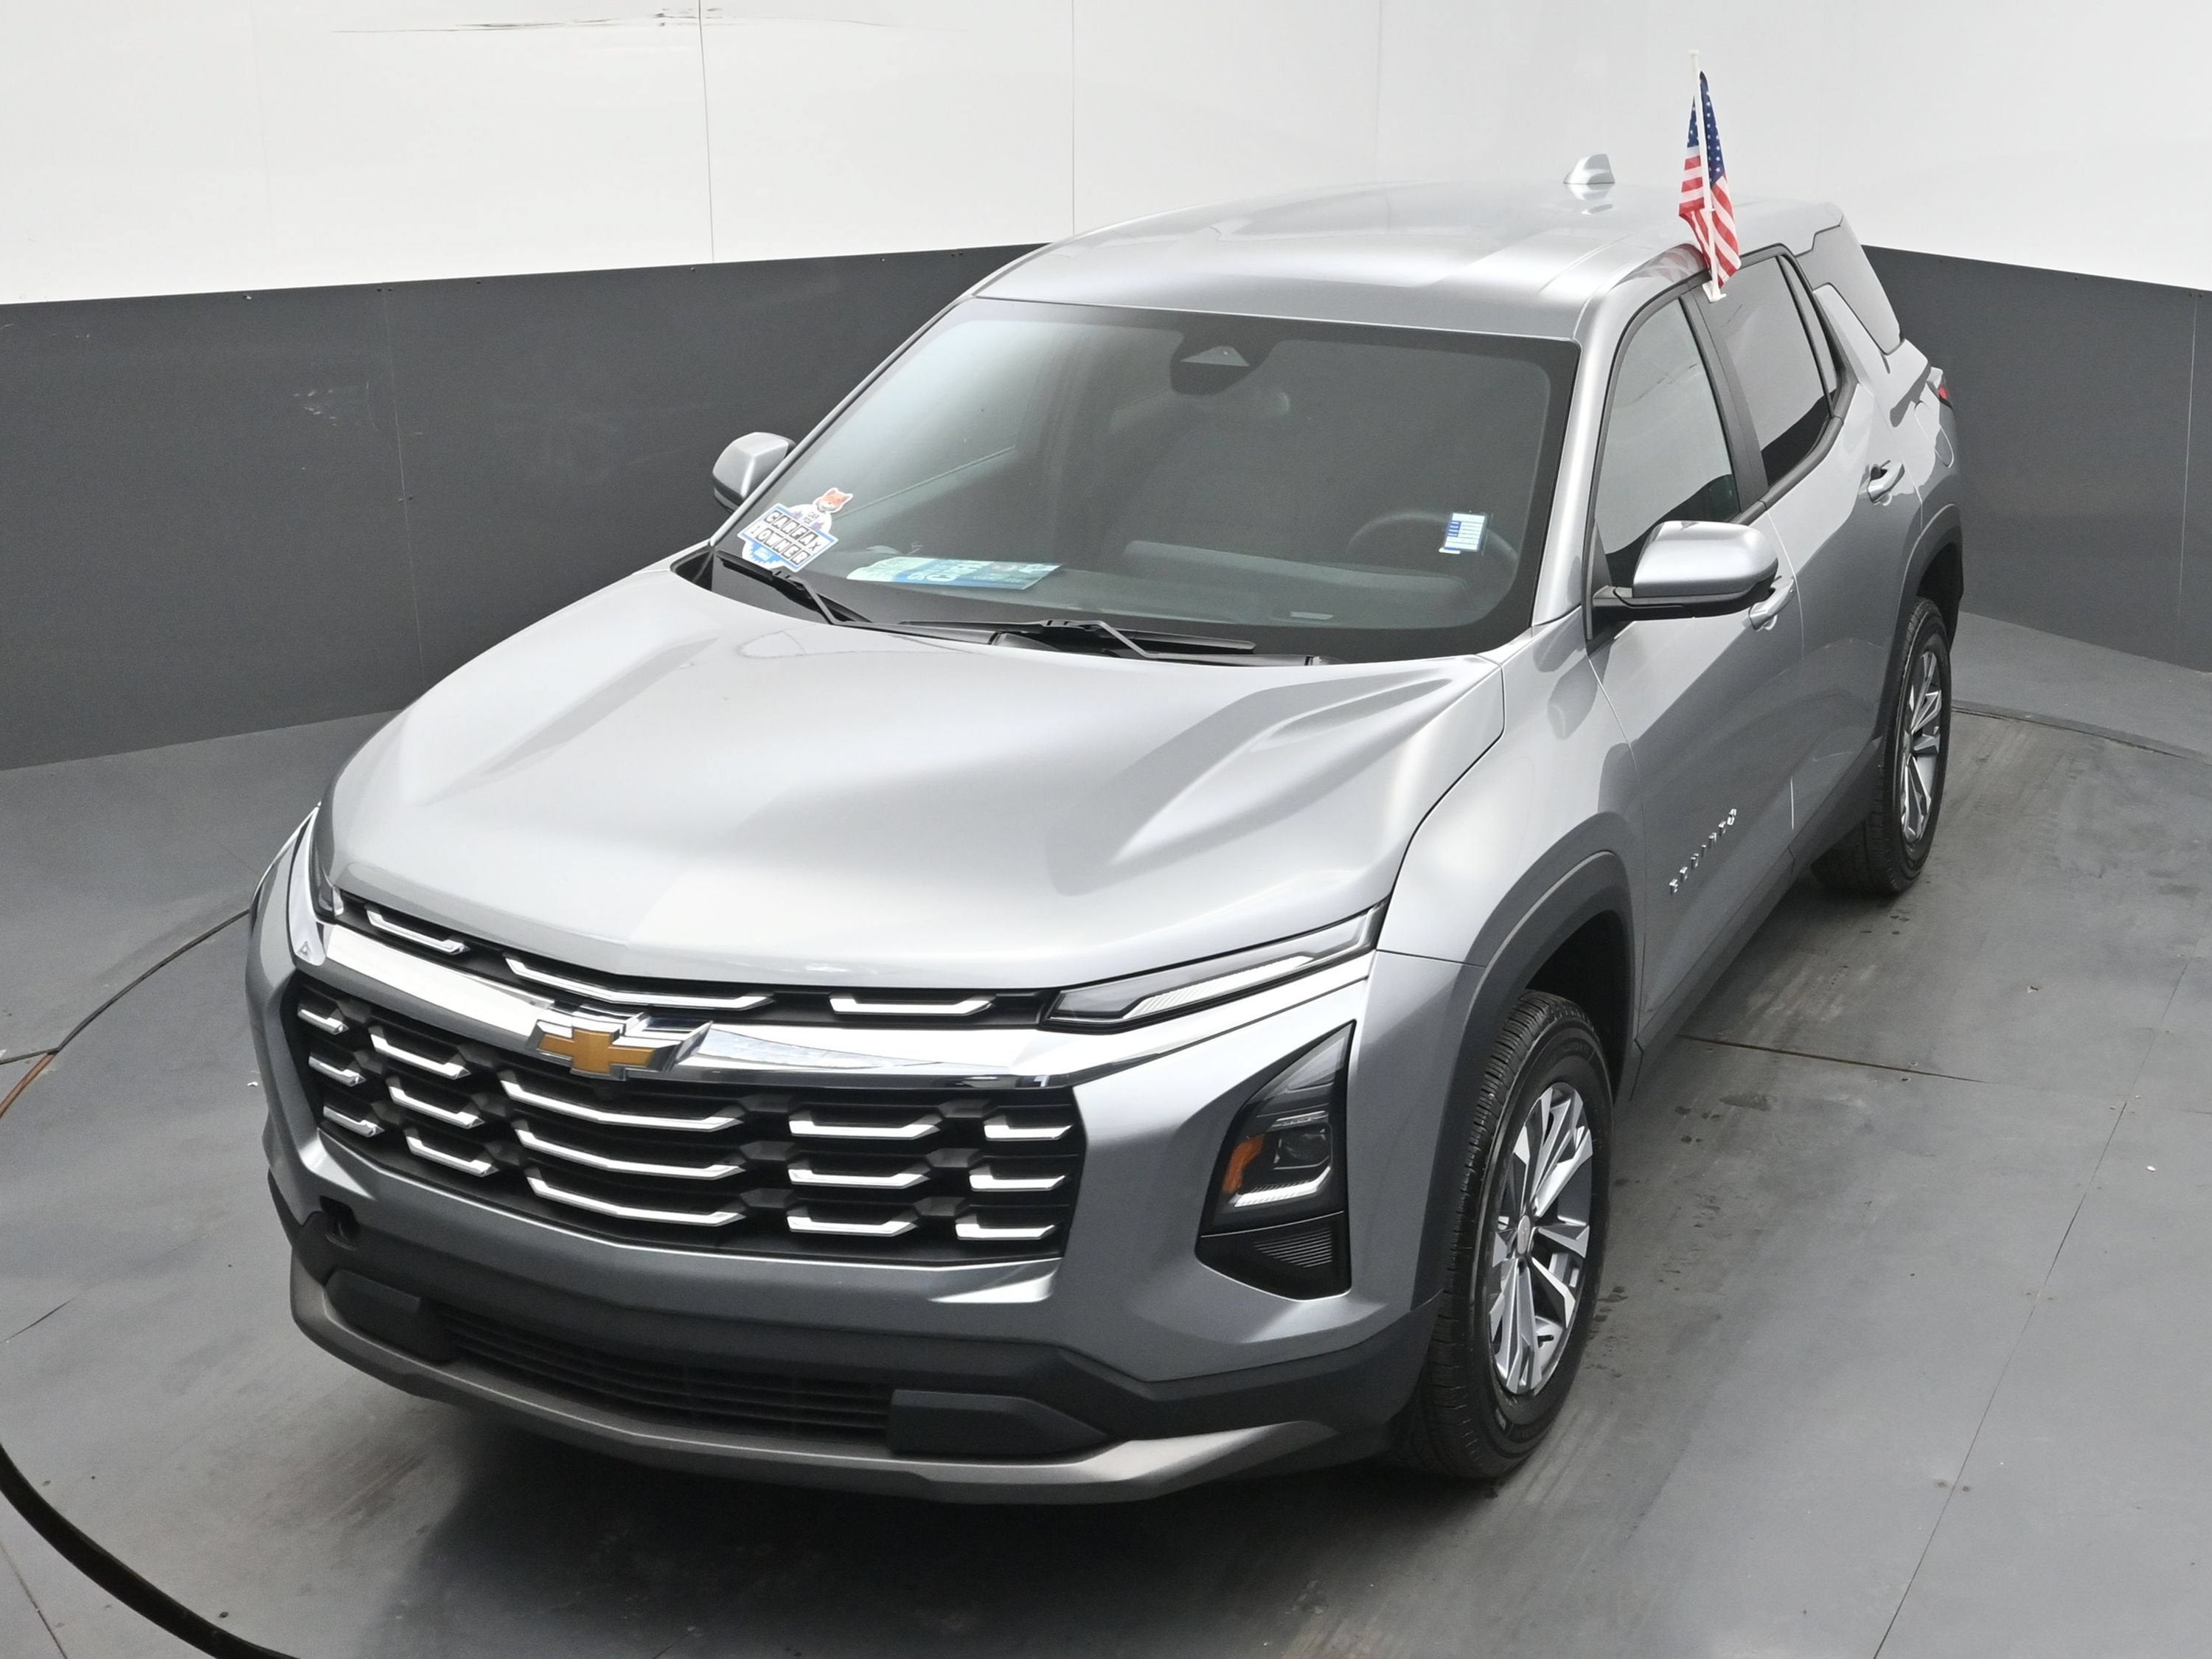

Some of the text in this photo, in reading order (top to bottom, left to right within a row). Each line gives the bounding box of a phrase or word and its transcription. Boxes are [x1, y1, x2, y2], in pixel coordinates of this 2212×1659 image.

[749, 525, 760, 535] 1
[755, 528, 812, 566] OWNER
[764, 509, 822, 552] CARFAX
